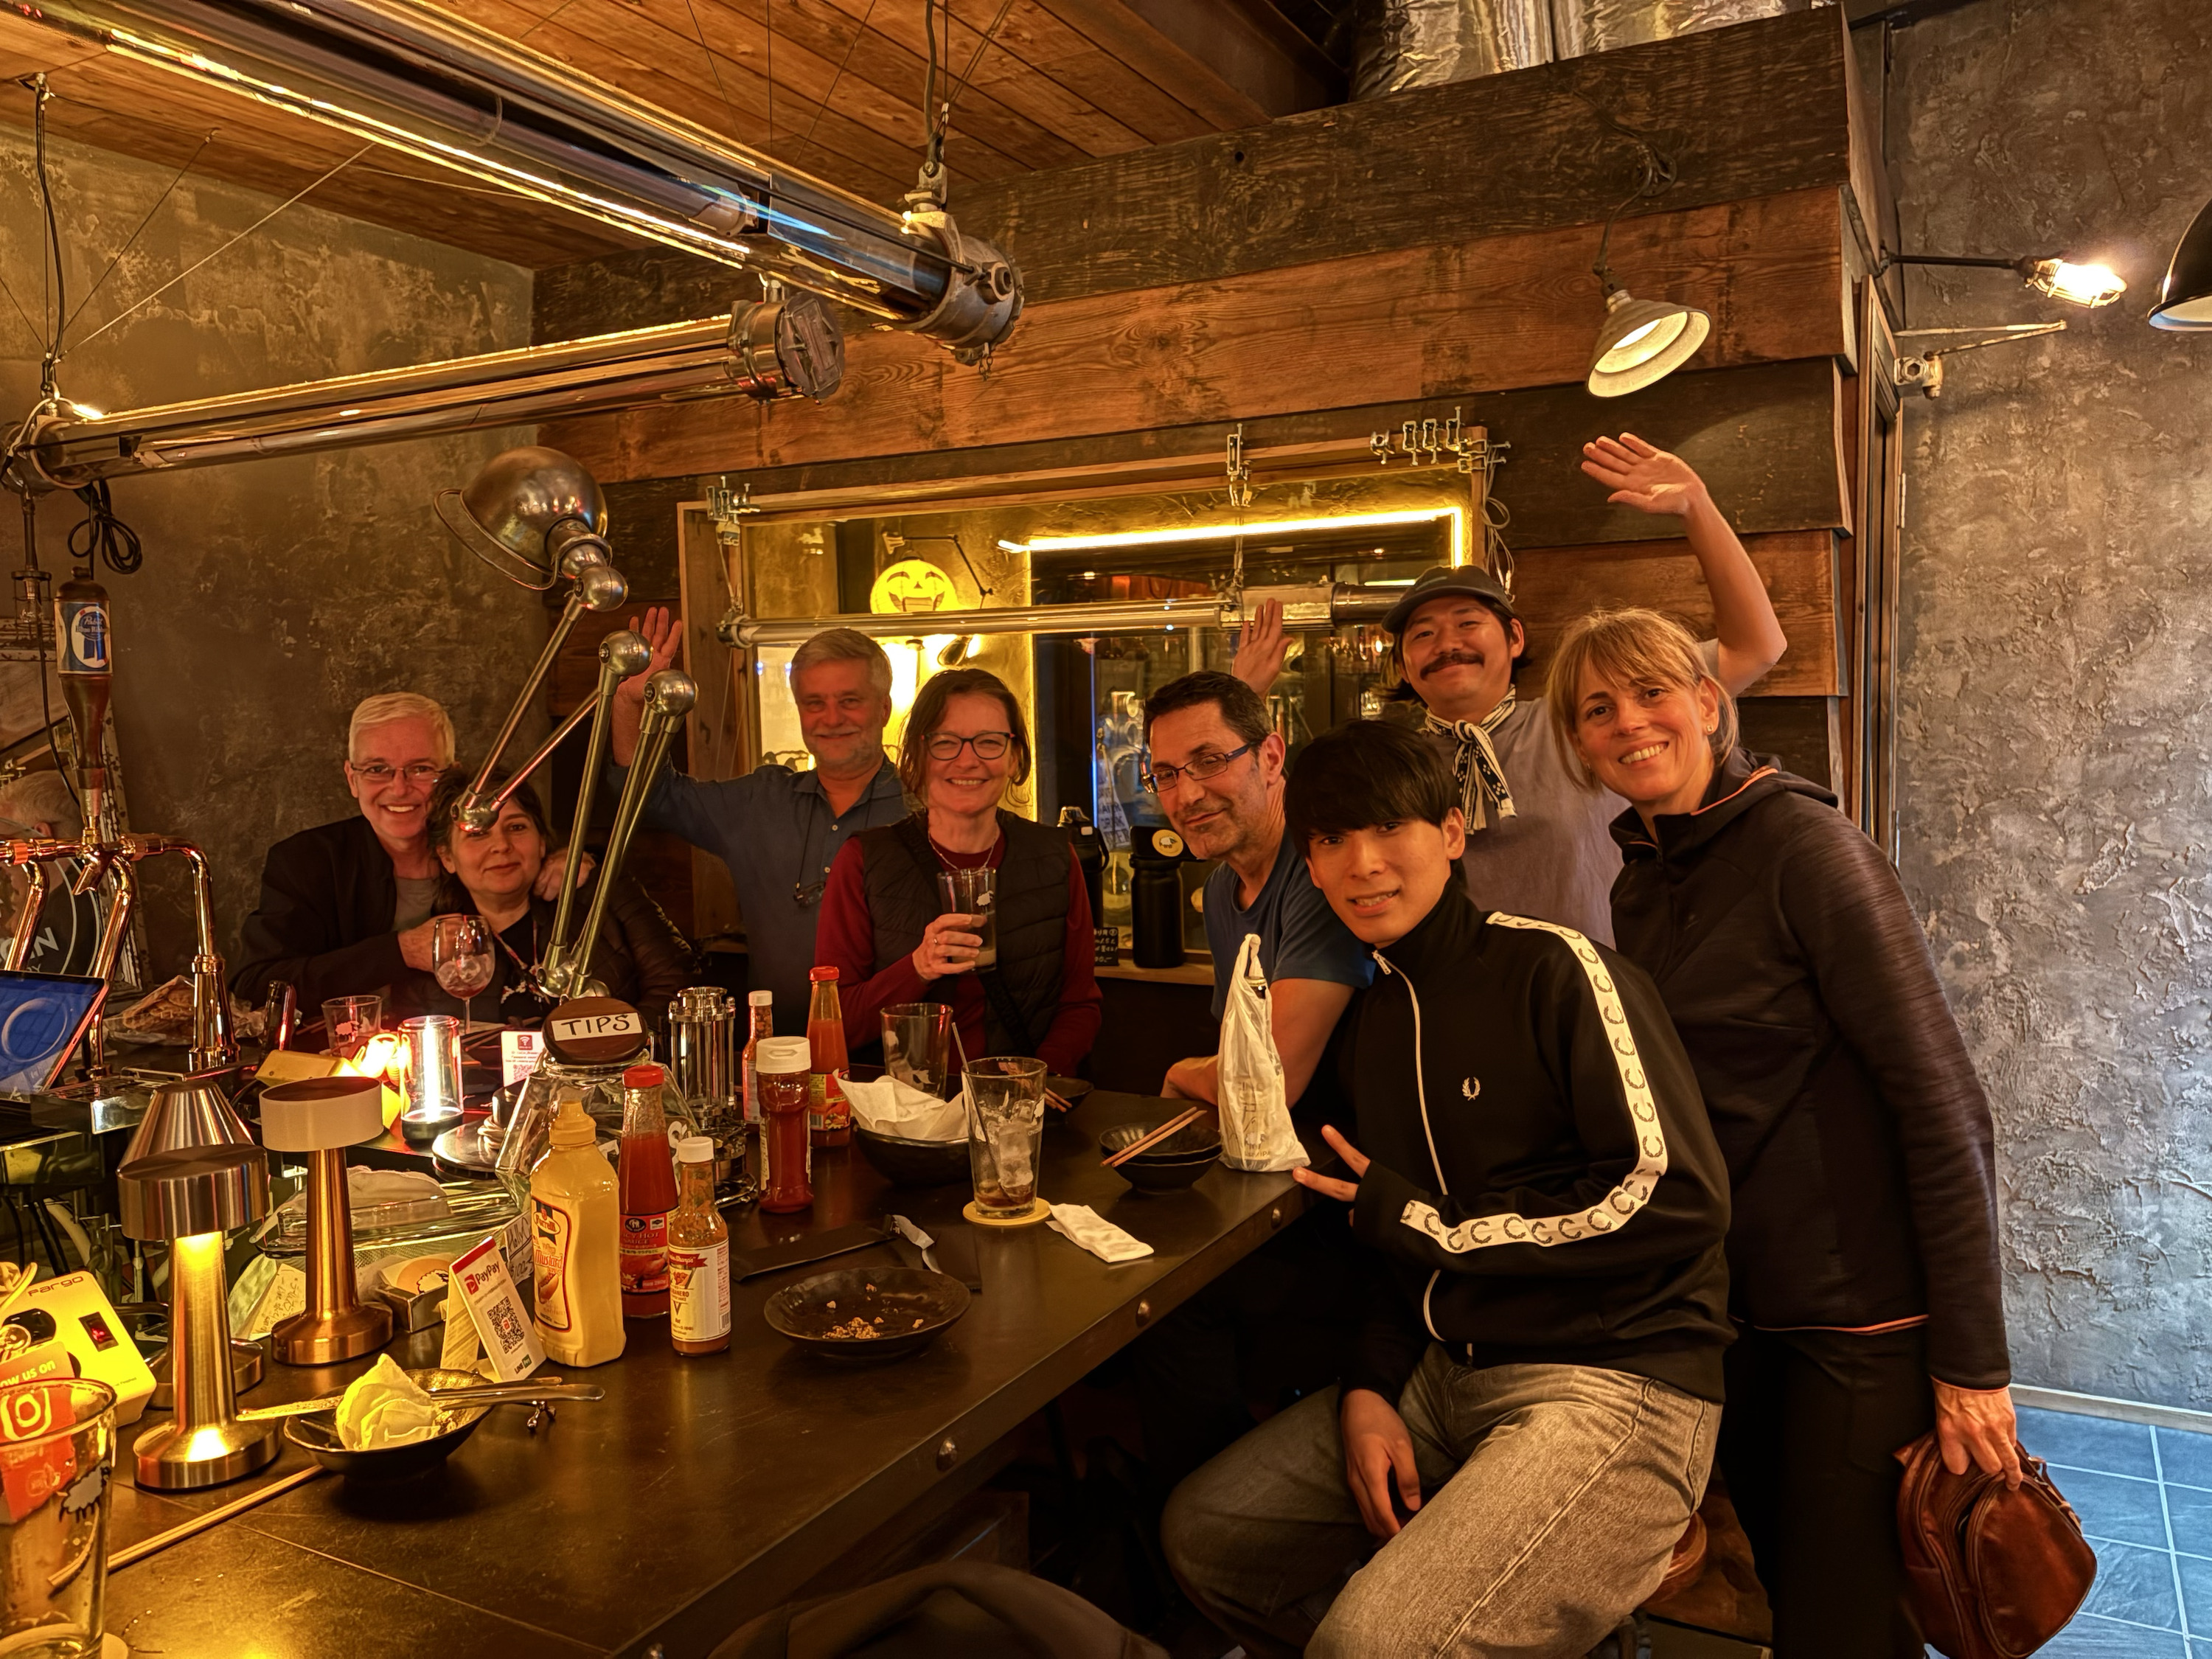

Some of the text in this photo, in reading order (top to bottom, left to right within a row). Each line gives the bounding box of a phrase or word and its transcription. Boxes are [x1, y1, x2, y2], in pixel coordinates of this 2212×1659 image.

[84, 616, 104, 625] Pabst
[560, 1014, 630, 1036] TIPS
[535, 1249, 563, 1269] Mustard
[475, 1261, 501, 1285] PayPay
[22, 1367, 38, 1379] us
[39, 1360, 56, 1374] on
[514, 1363, 524, 1374] LINE
